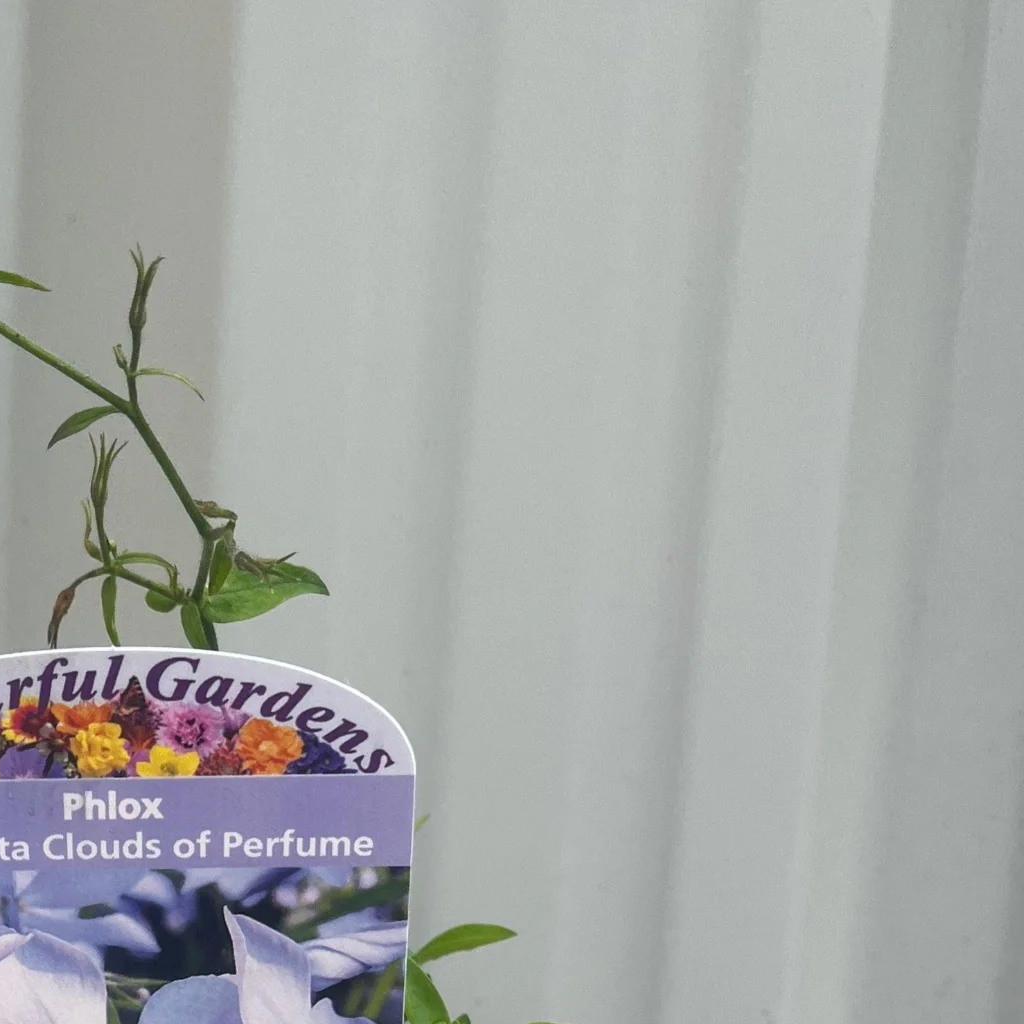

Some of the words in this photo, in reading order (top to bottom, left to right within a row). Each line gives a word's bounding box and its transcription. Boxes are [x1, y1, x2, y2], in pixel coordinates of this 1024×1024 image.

[144, 656, 396, 776] Gardens
[63, 791, 165, 821] Phlox
[42, 832, 162, 860] Clouds
[173, 830, 212, 859] of
[223, 831, 374, 859] Perfume
